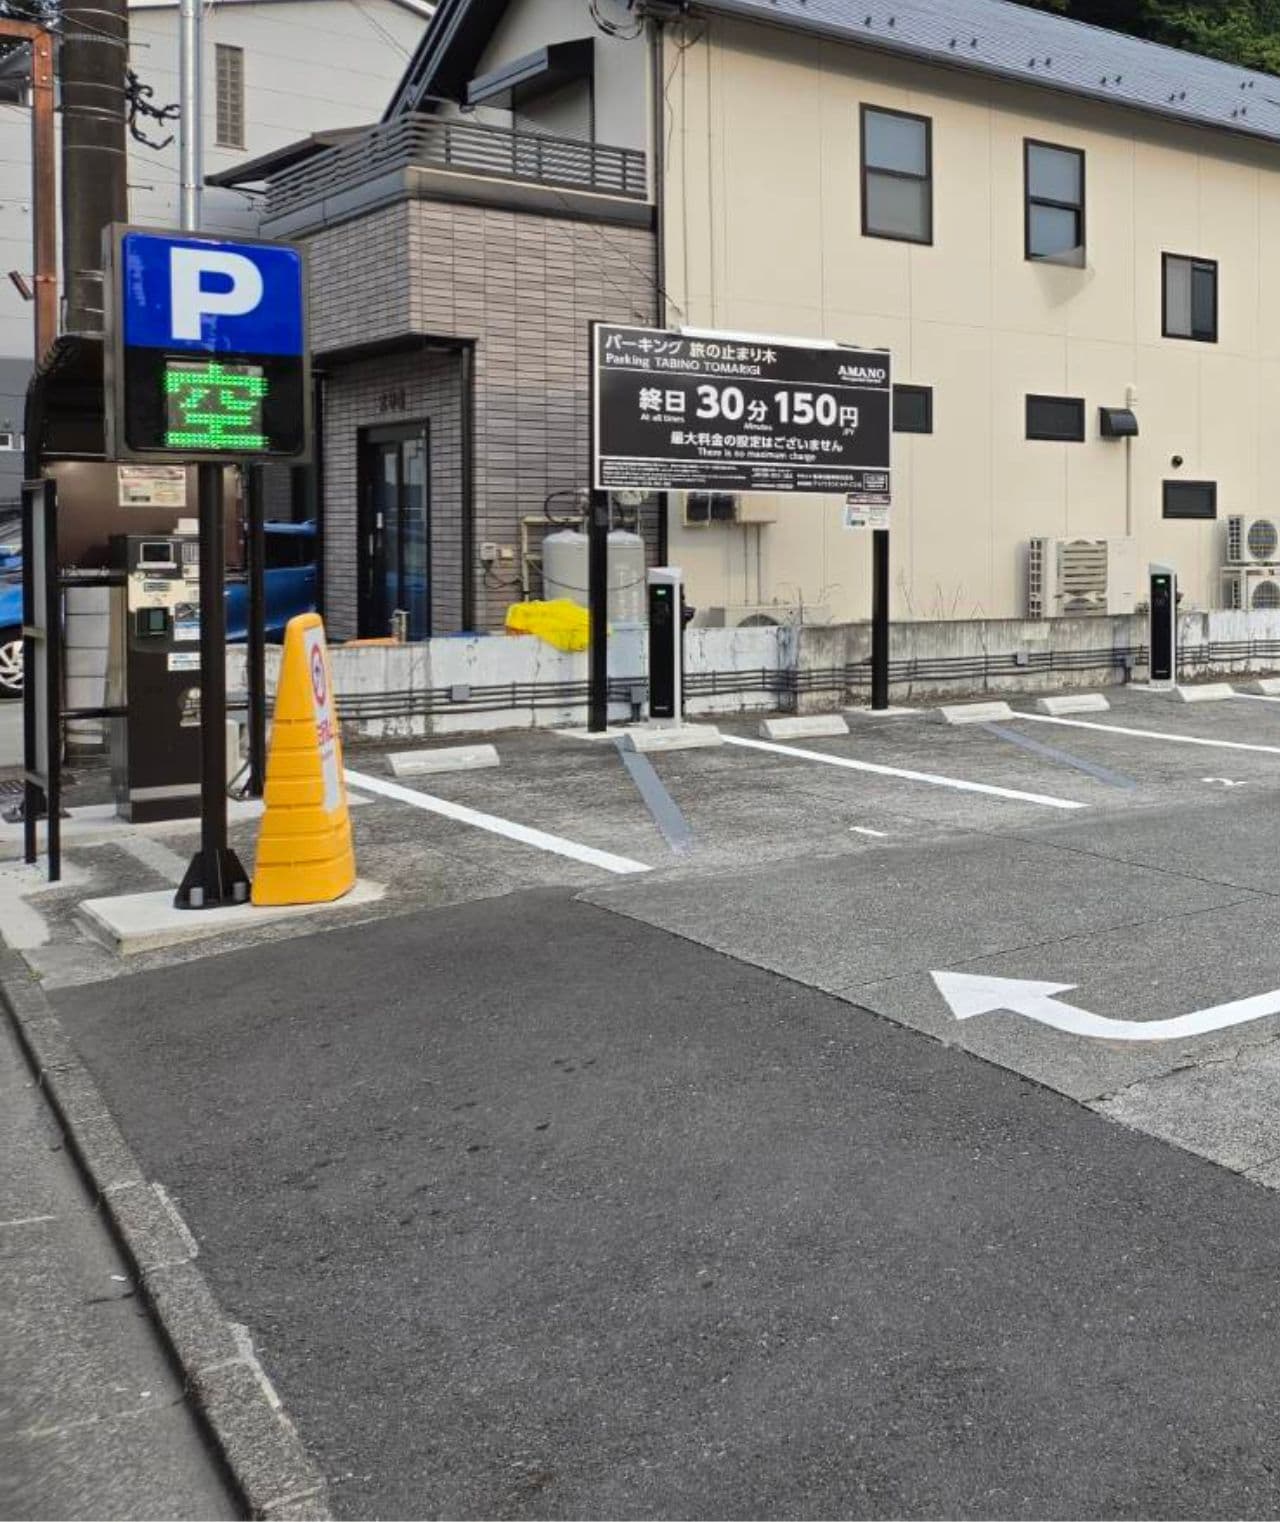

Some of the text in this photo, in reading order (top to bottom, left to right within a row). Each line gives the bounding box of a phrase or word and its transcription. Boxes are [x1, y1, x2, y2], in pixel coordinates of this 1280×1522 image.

[170, 246, 264, 340] P
[605, 334, 778, 364] パーキング 旅の止まり木
[606, 352, 761, 376] Parking TABINO TOMARIGI
[837, 364, 886, 381] AMANO
[164, 360, 271, 449] 空
[639, 387, 687, 413] 終日
[671, 430, 844, 453] 最大料金の設定はございません
[697, 446, 722, 457] There
[747, 450, 787, 460] maximum
